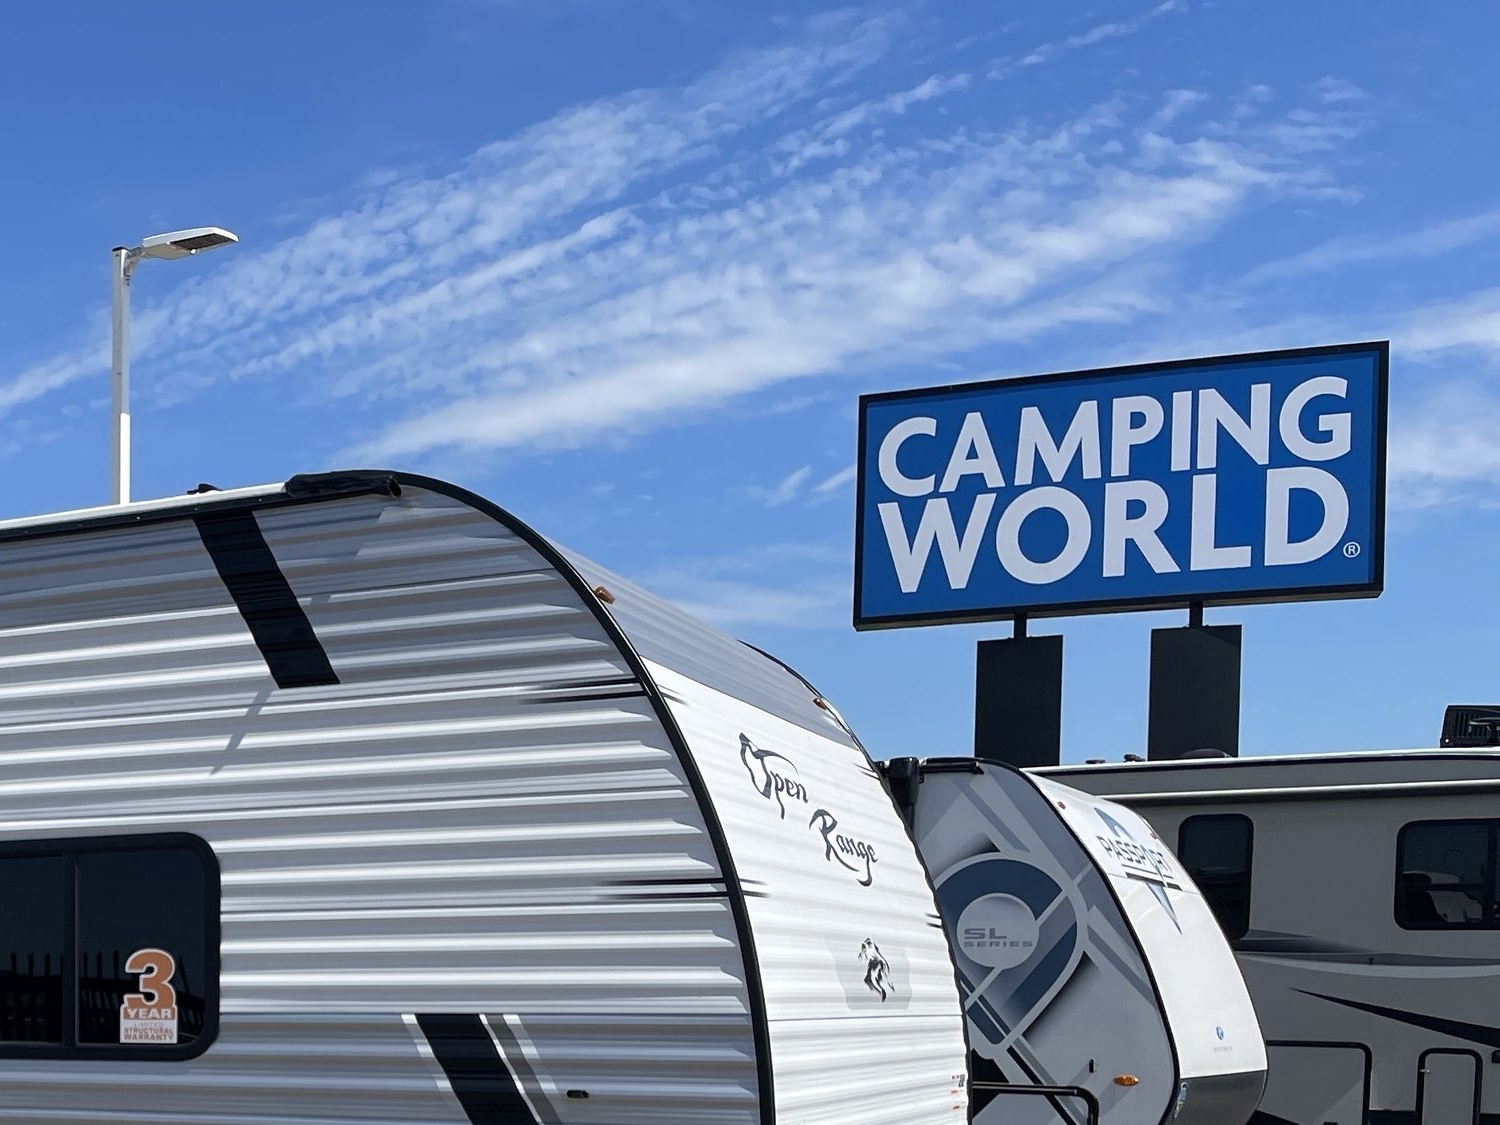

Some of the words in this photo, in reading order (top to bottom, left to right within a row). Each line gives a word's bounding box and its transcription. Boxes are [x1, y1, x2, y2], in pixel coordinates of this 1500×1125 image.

[878, 376, 1352, 497] CAMPING
[877, 466, 1349, 593] WORLD
[739, 732, 809, 819] Open
[809, 809, 879, 887] Range
[1096, 834, 1174, 873] PASSPORT
[964, 927, 1007, 939] SL
[124, 948, 176, 1007] 3
[124, 1033, 174, 1041] WARRANTY
[126, 1007, 172, 1019] YEAR
